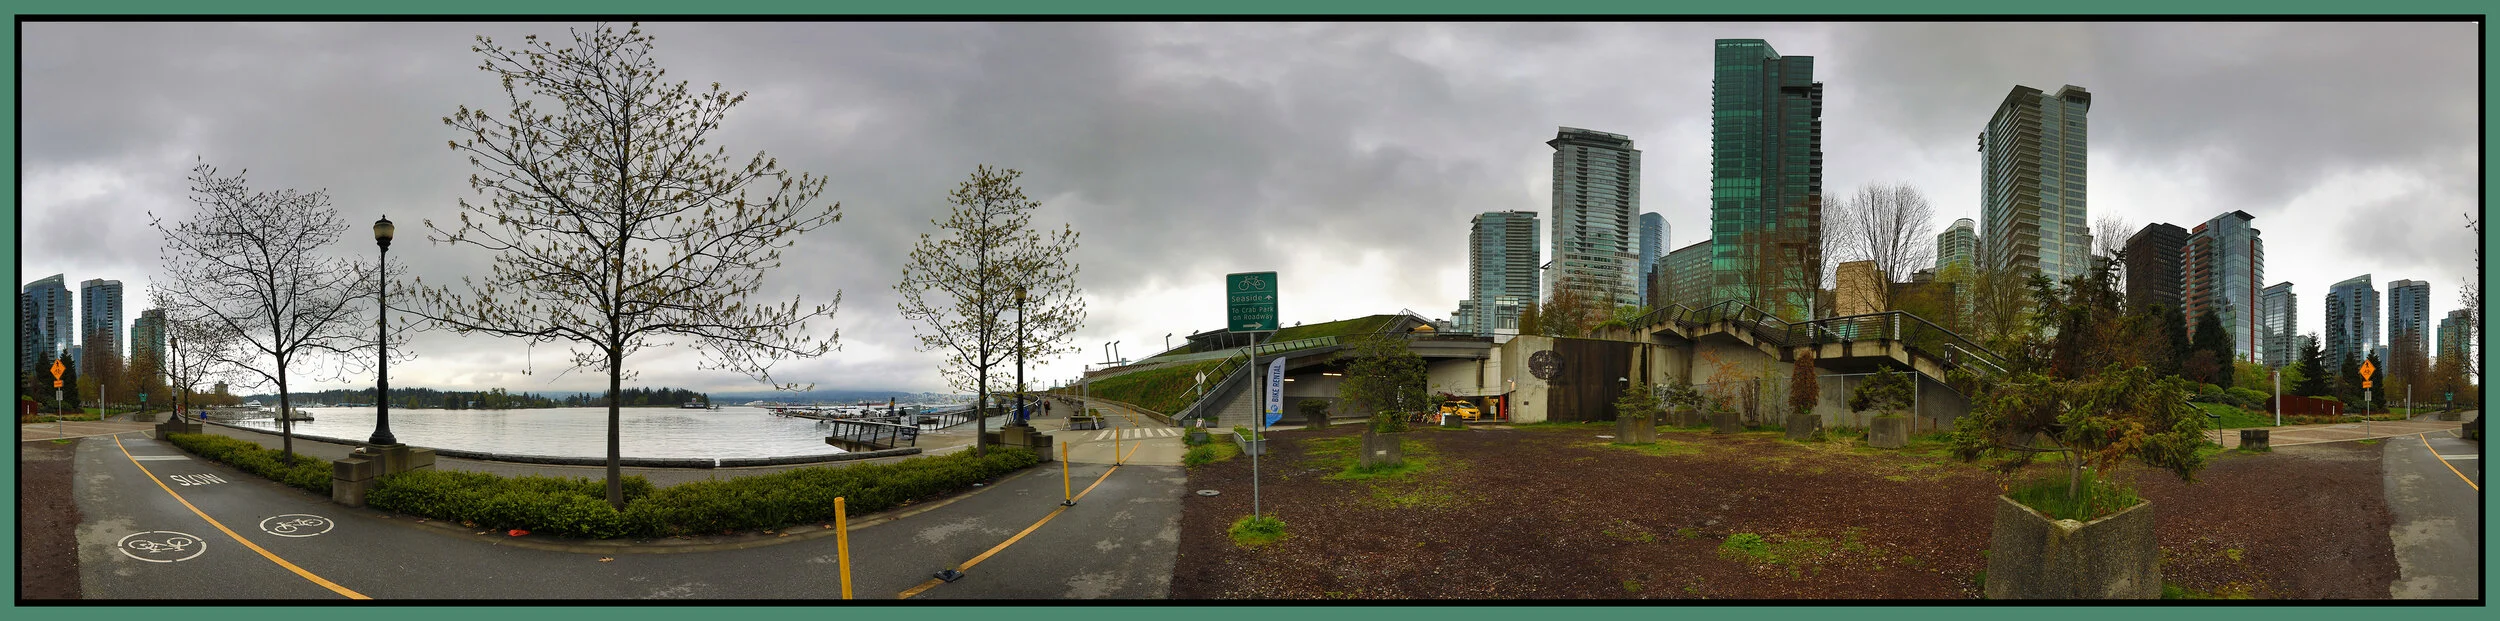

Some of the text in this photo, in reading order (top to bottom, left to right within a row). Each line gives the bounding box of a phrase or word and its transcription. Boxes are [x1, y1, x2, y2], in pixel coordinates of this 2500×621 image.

[1231, 295, 1263, 303] Seaside
[1271, 365, 1281, 403] BIKE RENTAL
[170, 473, 228, 487] SLOW
